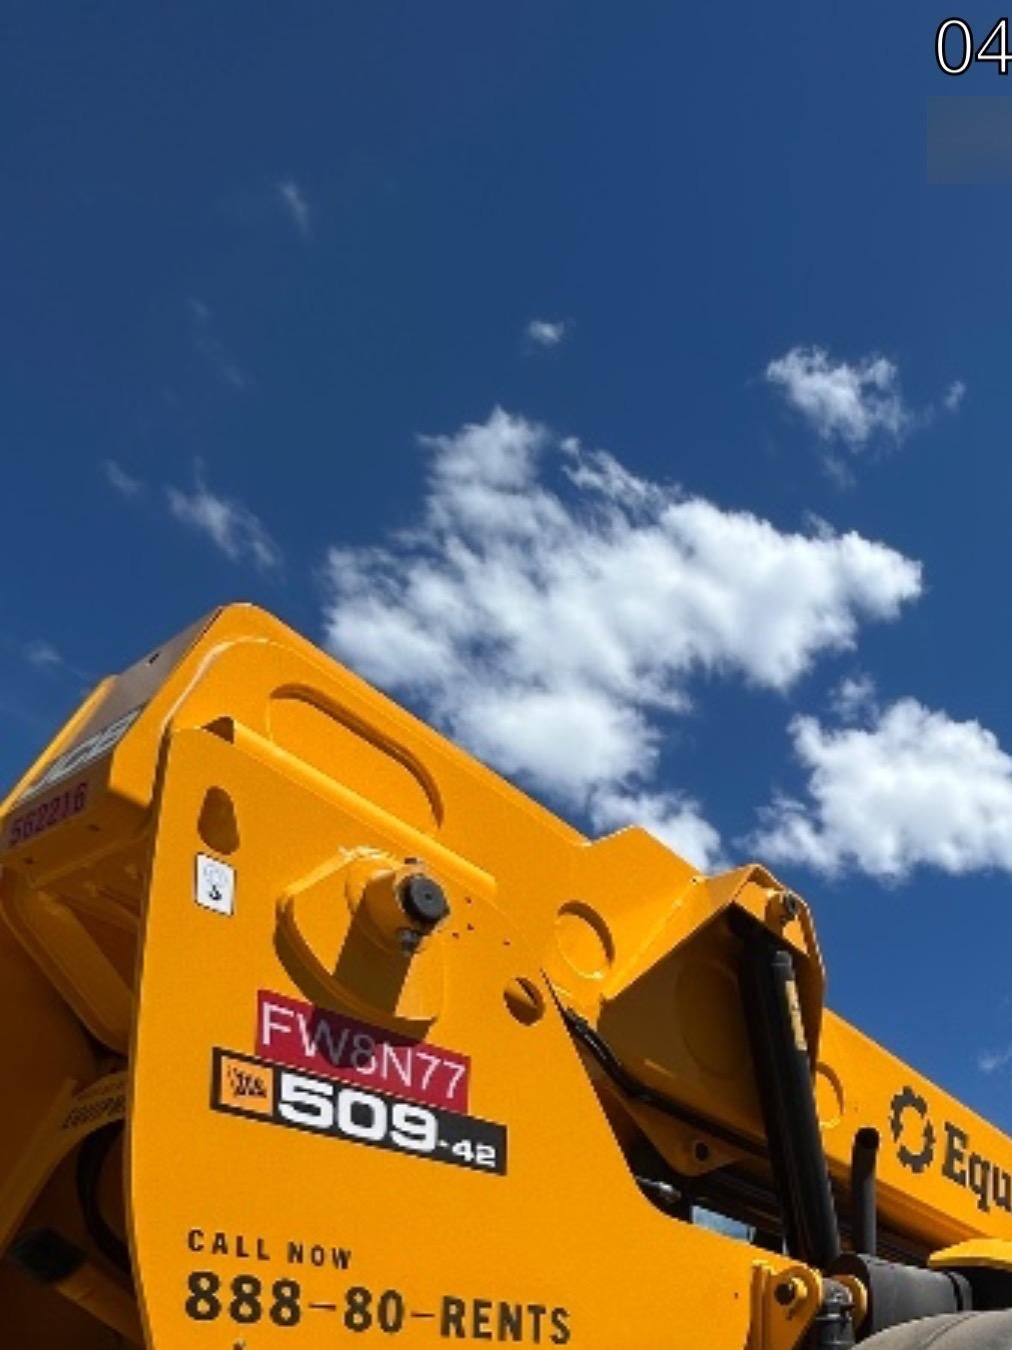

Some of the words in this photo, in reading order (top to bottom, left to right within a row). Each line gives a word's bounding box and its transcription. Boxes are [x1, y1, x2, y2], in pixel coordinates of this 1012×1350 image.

[261, 1000, 466, 1099] FW8N77
[277, 1070, 497, 1168] 509-42
[187, 1228, 271, 1261] CALL
[287, 1240, 352, 1270] NOW
[185, 1270, 571, 1345] 888-80-RENTS
